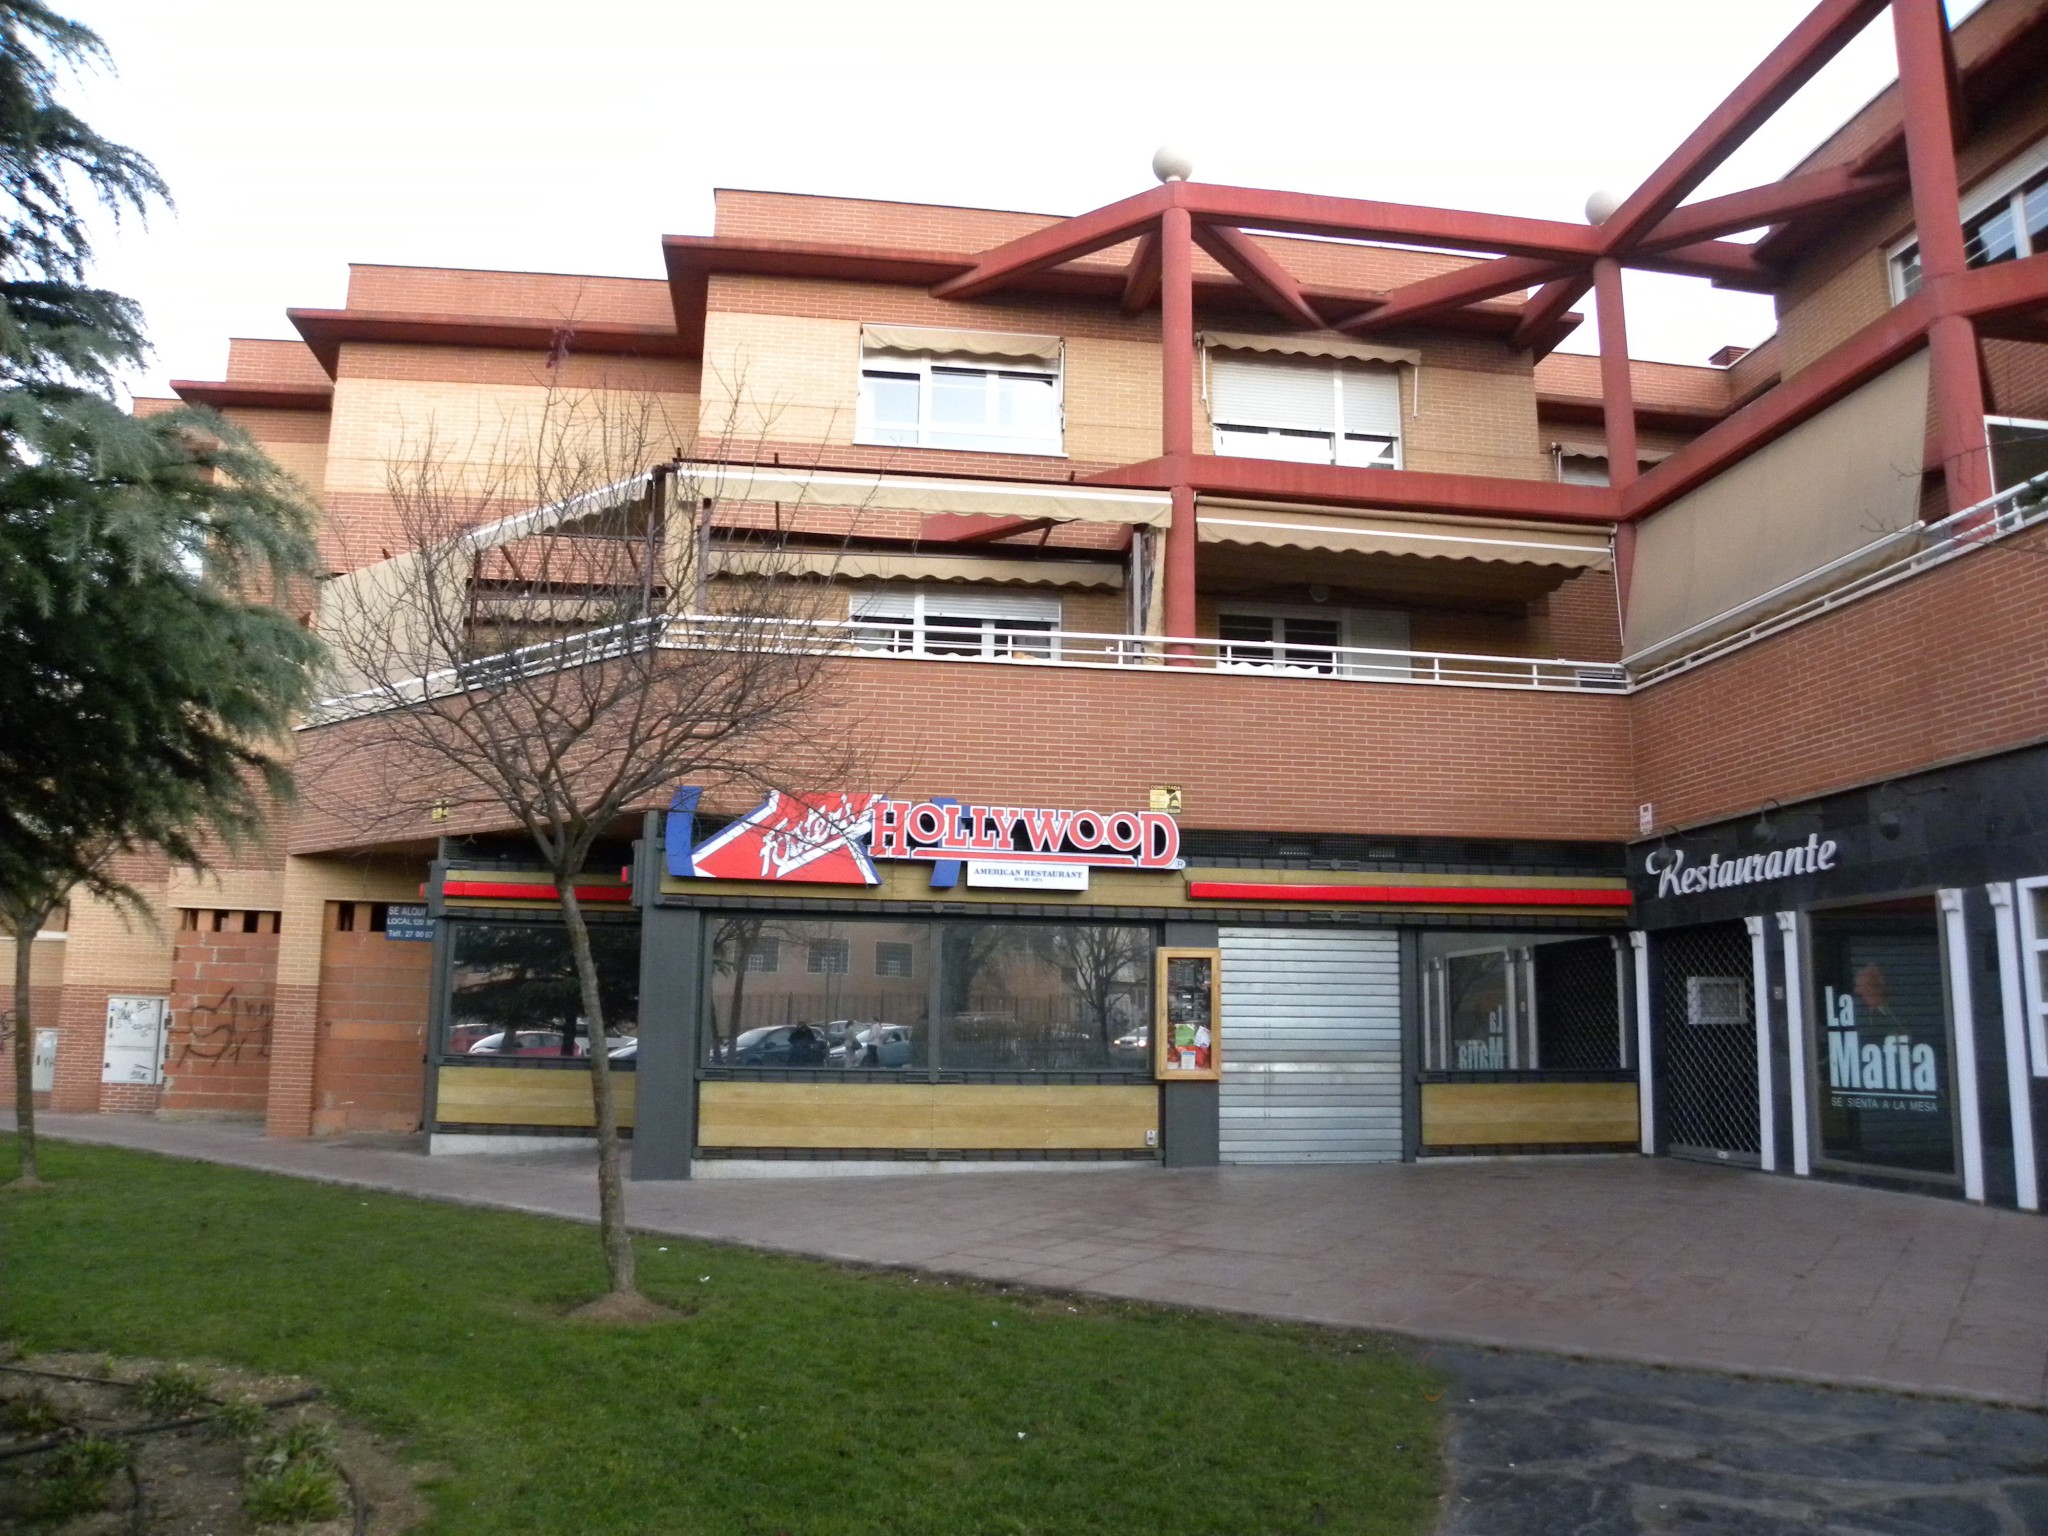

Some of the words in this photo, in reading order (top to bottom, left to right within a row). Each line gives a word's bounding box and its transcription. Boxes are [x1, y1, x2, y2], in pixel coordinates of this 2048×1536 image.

[867, 800, 1180, 869] HOLLYWOOD
[974, 868, 1021, 877] AMERICAN
[1024, 869, 1083, 879] RESTAURANT
[1645, 832, 1837, 899] Restaurante
[389, 906, 400, 915] SE
[401, 907, 426, 916] ALQUI
[1825, 985, 1855, 1027] La
[1828, 1030, 1937, 1092] Mafia
[1831, 1096, 1842, 1107] SE
[1847, 1098, 1879, 1109] SIENTA
[1882, 1099, 1890, 1110] A
[1893, 1100, 1906, 1111] LA
[1909, 1101, 1938, 1113] MESA
